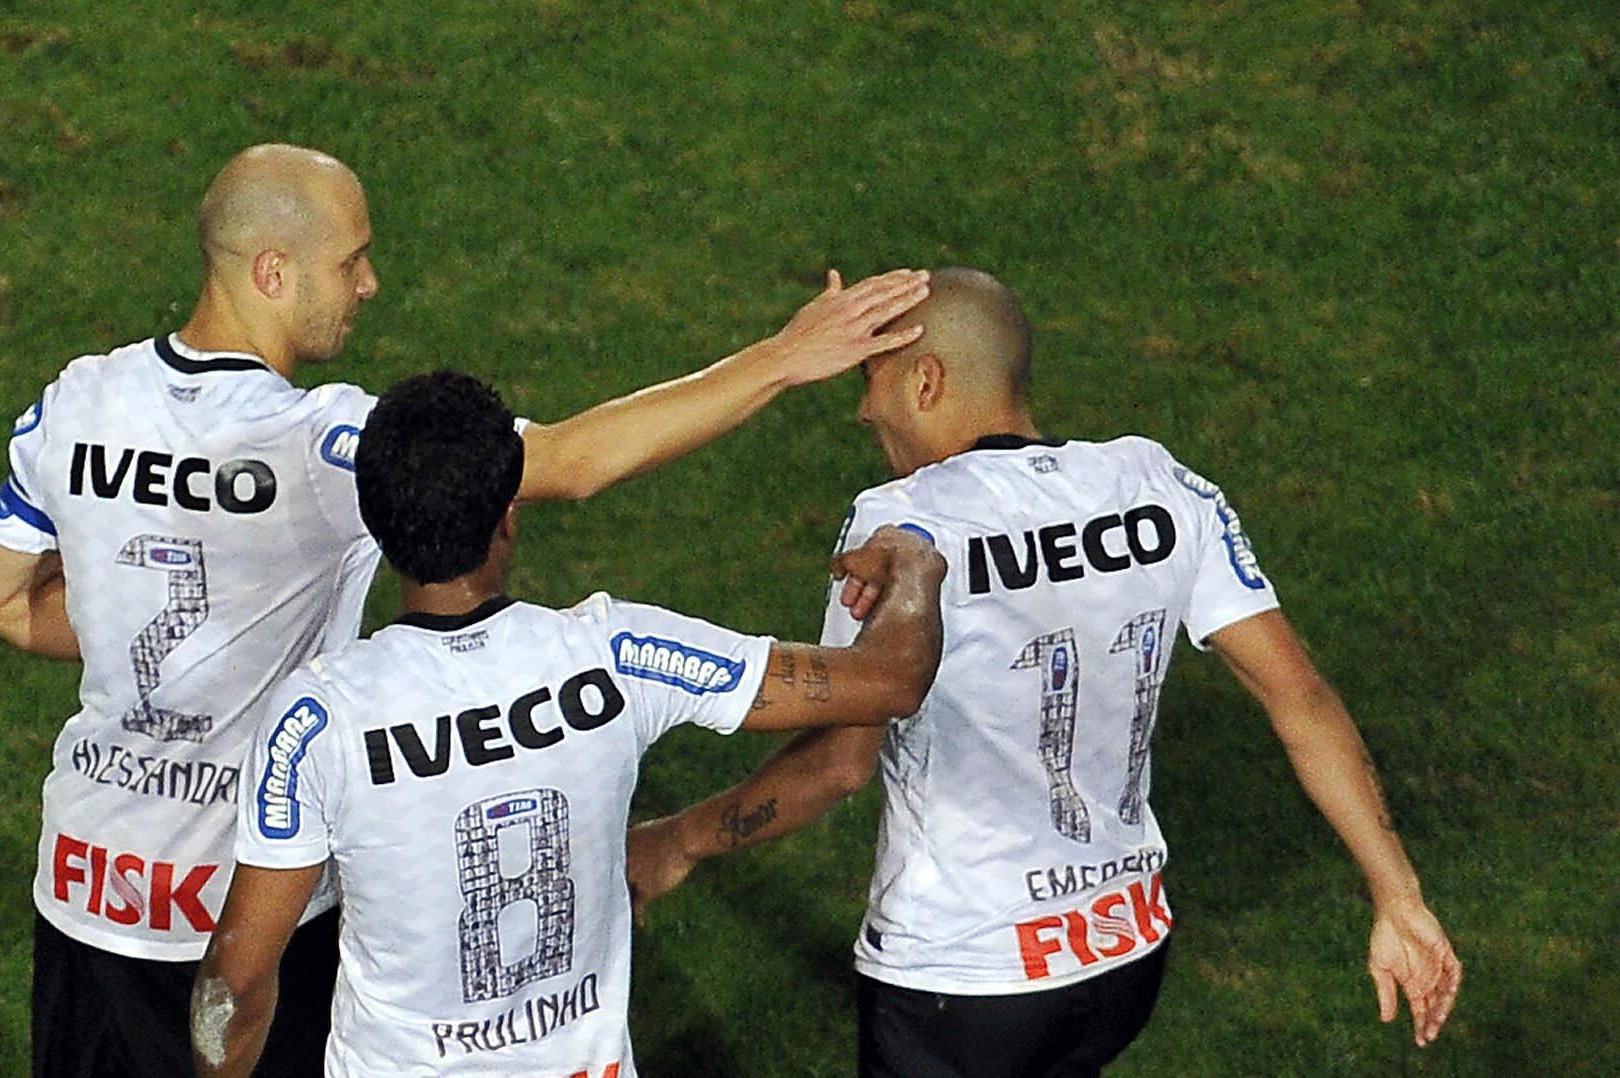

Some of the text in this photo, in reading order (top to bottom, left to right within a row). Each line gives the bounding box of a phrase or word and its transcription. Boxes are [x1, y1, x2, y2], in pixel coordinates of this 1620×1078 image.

[70, 443, 278, 513] IVECO
[968, 504, 1176, 594] IVECO
[116, 533, 210, 742] 2
[619, 638, 733, 688] MARABRA
[71, 738, 240, 806] ALESSANDR
[363, 667, 625, 785] IVECO
[1010, 608, 1166, 844] 11
[54, 832, 219, 933] FISK
[453, 787, 576, 1005] 8
[1016, 872, 1174, 980] FISK
[432, 973, 600, 1058] PAULINHO
